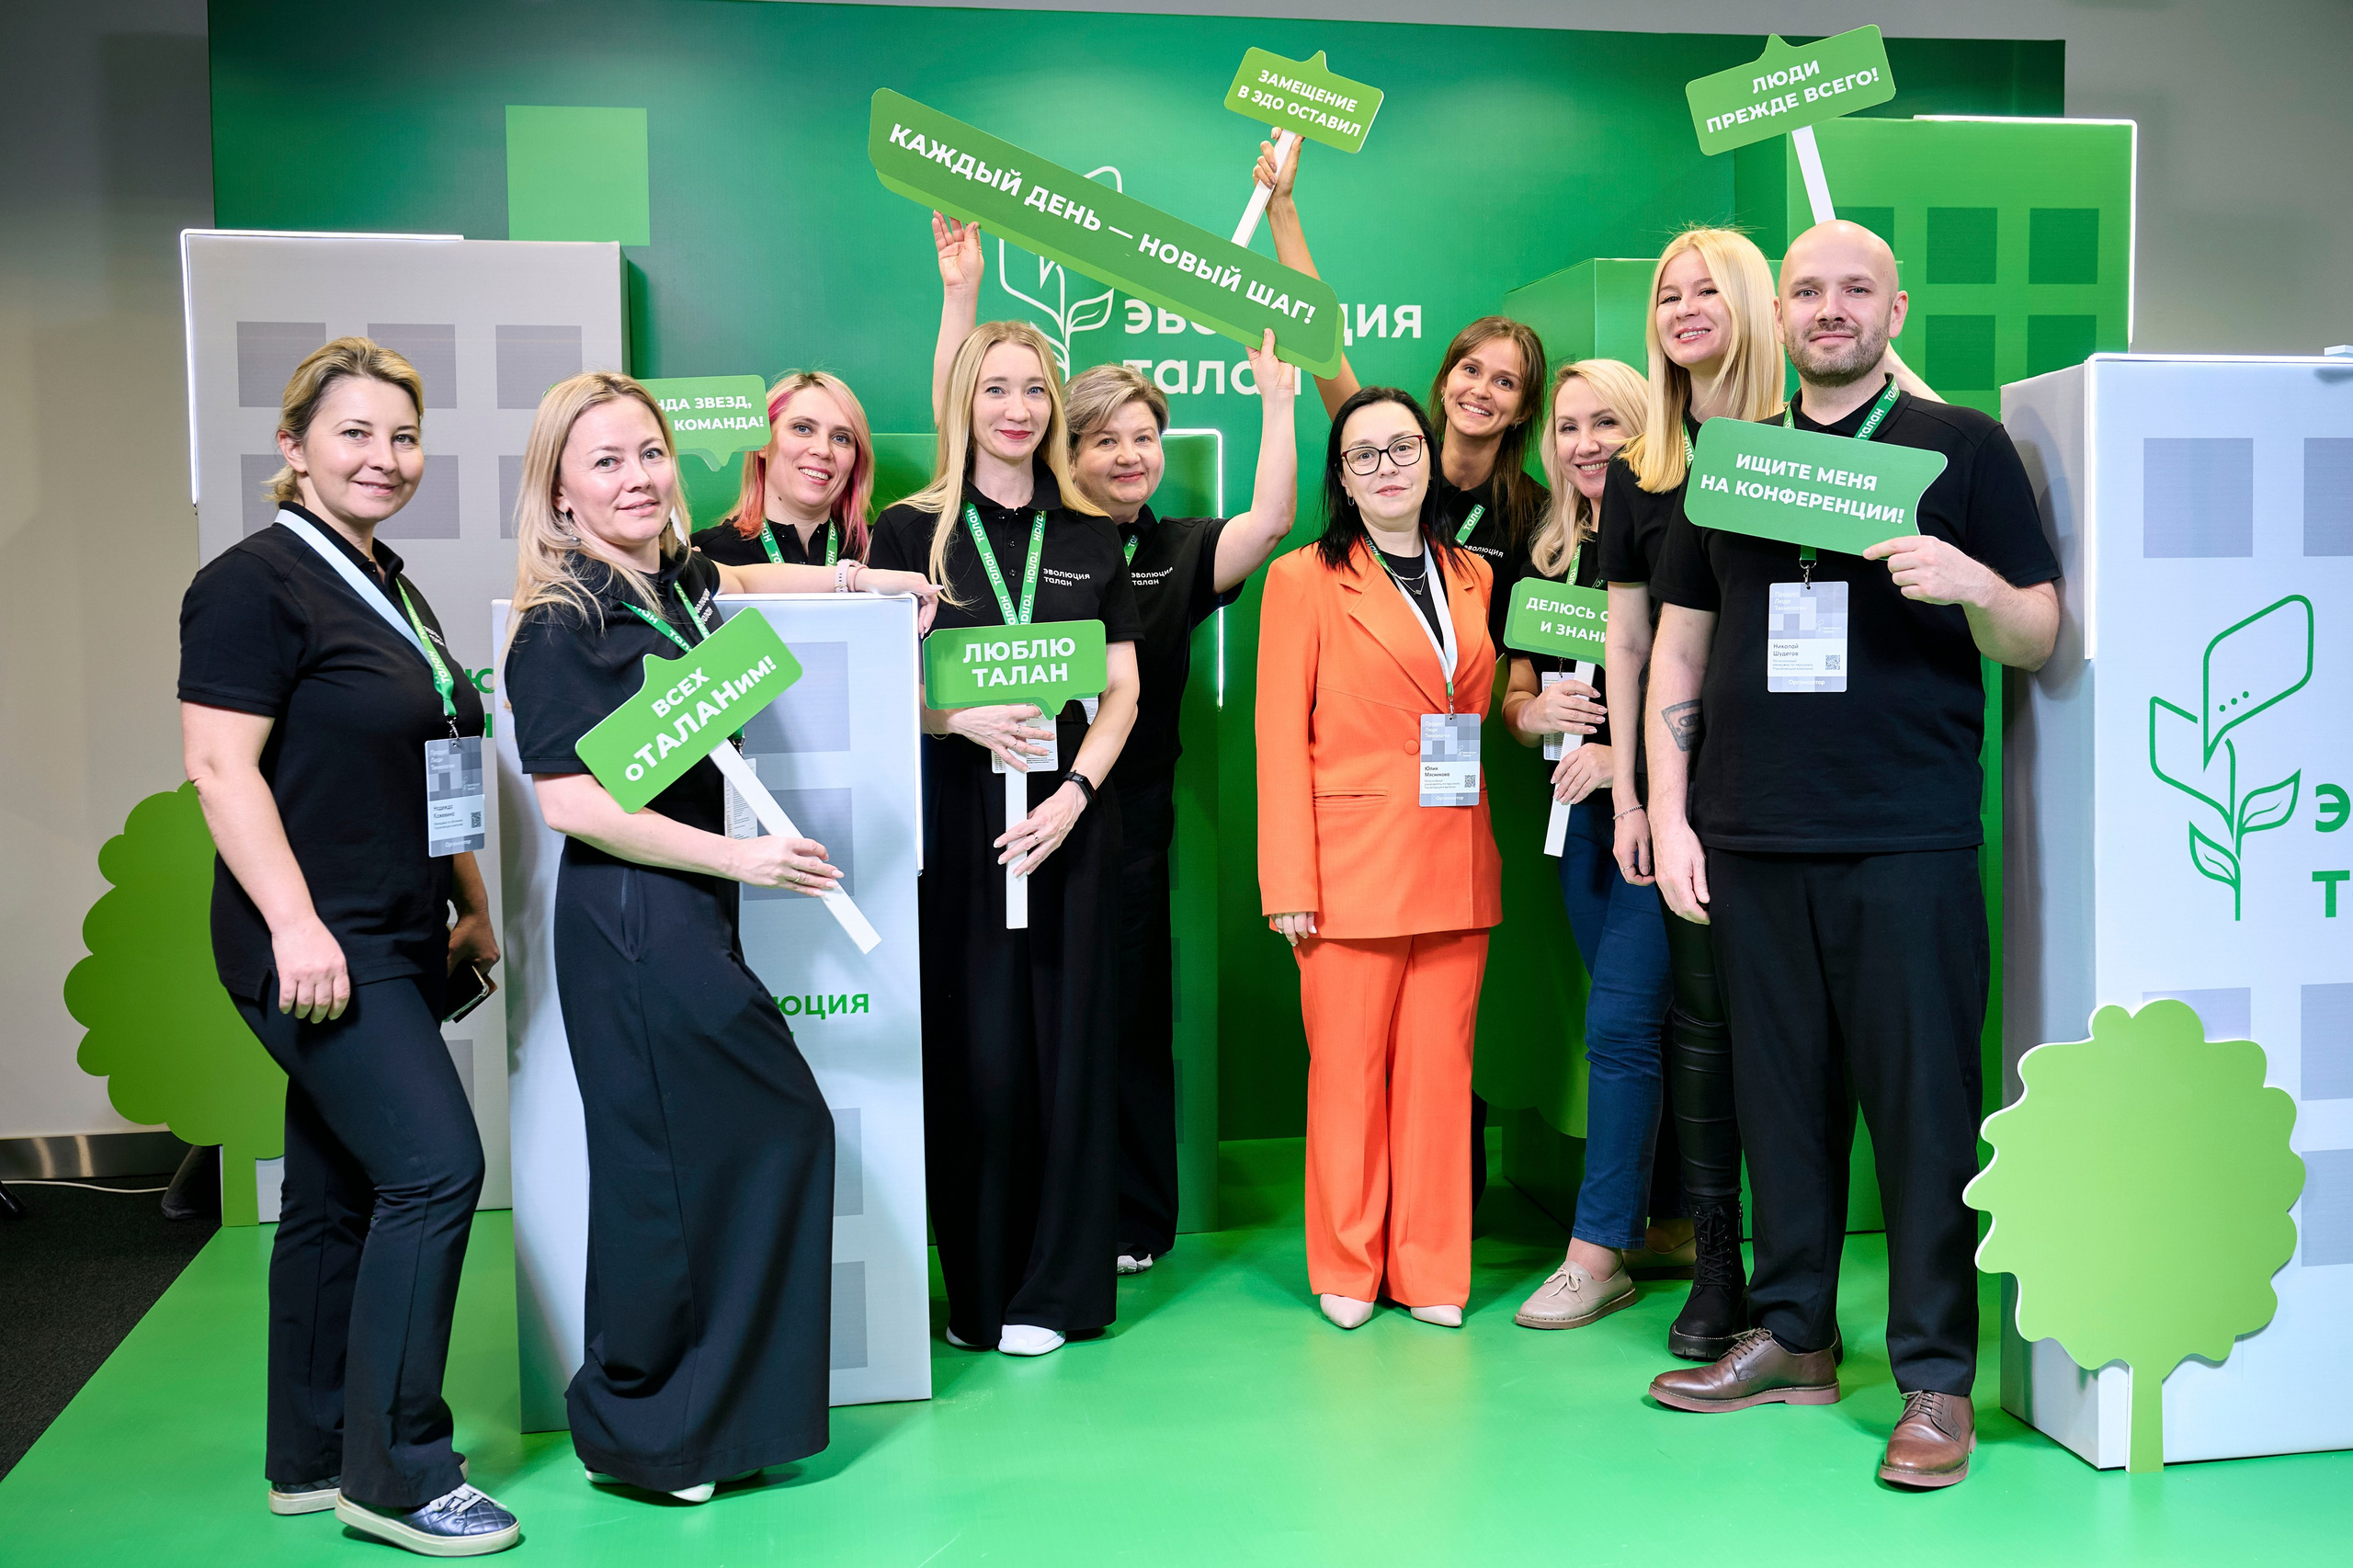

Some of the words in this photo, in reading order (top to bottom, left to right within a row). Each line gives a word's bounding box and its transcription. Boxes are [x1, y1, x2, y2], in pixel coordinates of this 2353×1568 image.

[1257, 69, 1358, 113] ЗАМЕЩЕНИЕ
[1752, 60, 1821, 94] ЛЮДИ
[1237, 85, 1250, 98] В
[1251, 89, 1286, 110] ЭДО
[1287, 102, 1362, 137] ОСТАВИЛ
[1706, 92, 1800, 133] ПРЕЖДЕ
[1803, 67, 1880, 103] ВСЕГО!
[889, 123, 1023, 197] КАЖДЫЙ
[1023, 185, 1101, 232] ДЕНЬ
[1138, 233, 1243, 292] НОВЫЙ
[1245, 279, 1316, 324] ШАГ!
[693, 395, 753, 410] ЗВЕЗД,
[673, 415, 765, 432] КОМАНДА!
[1857, 407, 1885, 439] талан
[1735, 453, 1813, 481] ИЩИТЕ
[1815, 466, 1878, 492] МЕНЯ
[1699, 473, 1729, 494] НА
[1734, 480, 1905, 525] КОНФЕРЕНЦИИ!
[967, 508, 985, 543] талан
[983, 551, 1003, 586] талан
[1026, 551, 1039, 584] талан
[1042, 567, 1091, 581] эволюция
[1043, 575, 1073, 586] талан
[1131, 566, 1174, 579] эволюция
[1131, 578, 1160, 586] талан
[1000, 595, 1017, 625] алан
[1020, 594, 1032, 625] тала
[1525, 597, 1596, 619] ДЕЛЮСЬ
[1540, 620, 1552, 634] И
[1554, 623, 1607, 643] ЗНАНИ
[962, 637, 1076, 664] ЛЮБЛЮ
[427, 650, 450, 684] талан
[971, 662, 1068, 688] ТАЛАН
[651, 666, 710, 719] ВСЕХ
[624, 654, 777, 782] оТАЛАНим!
